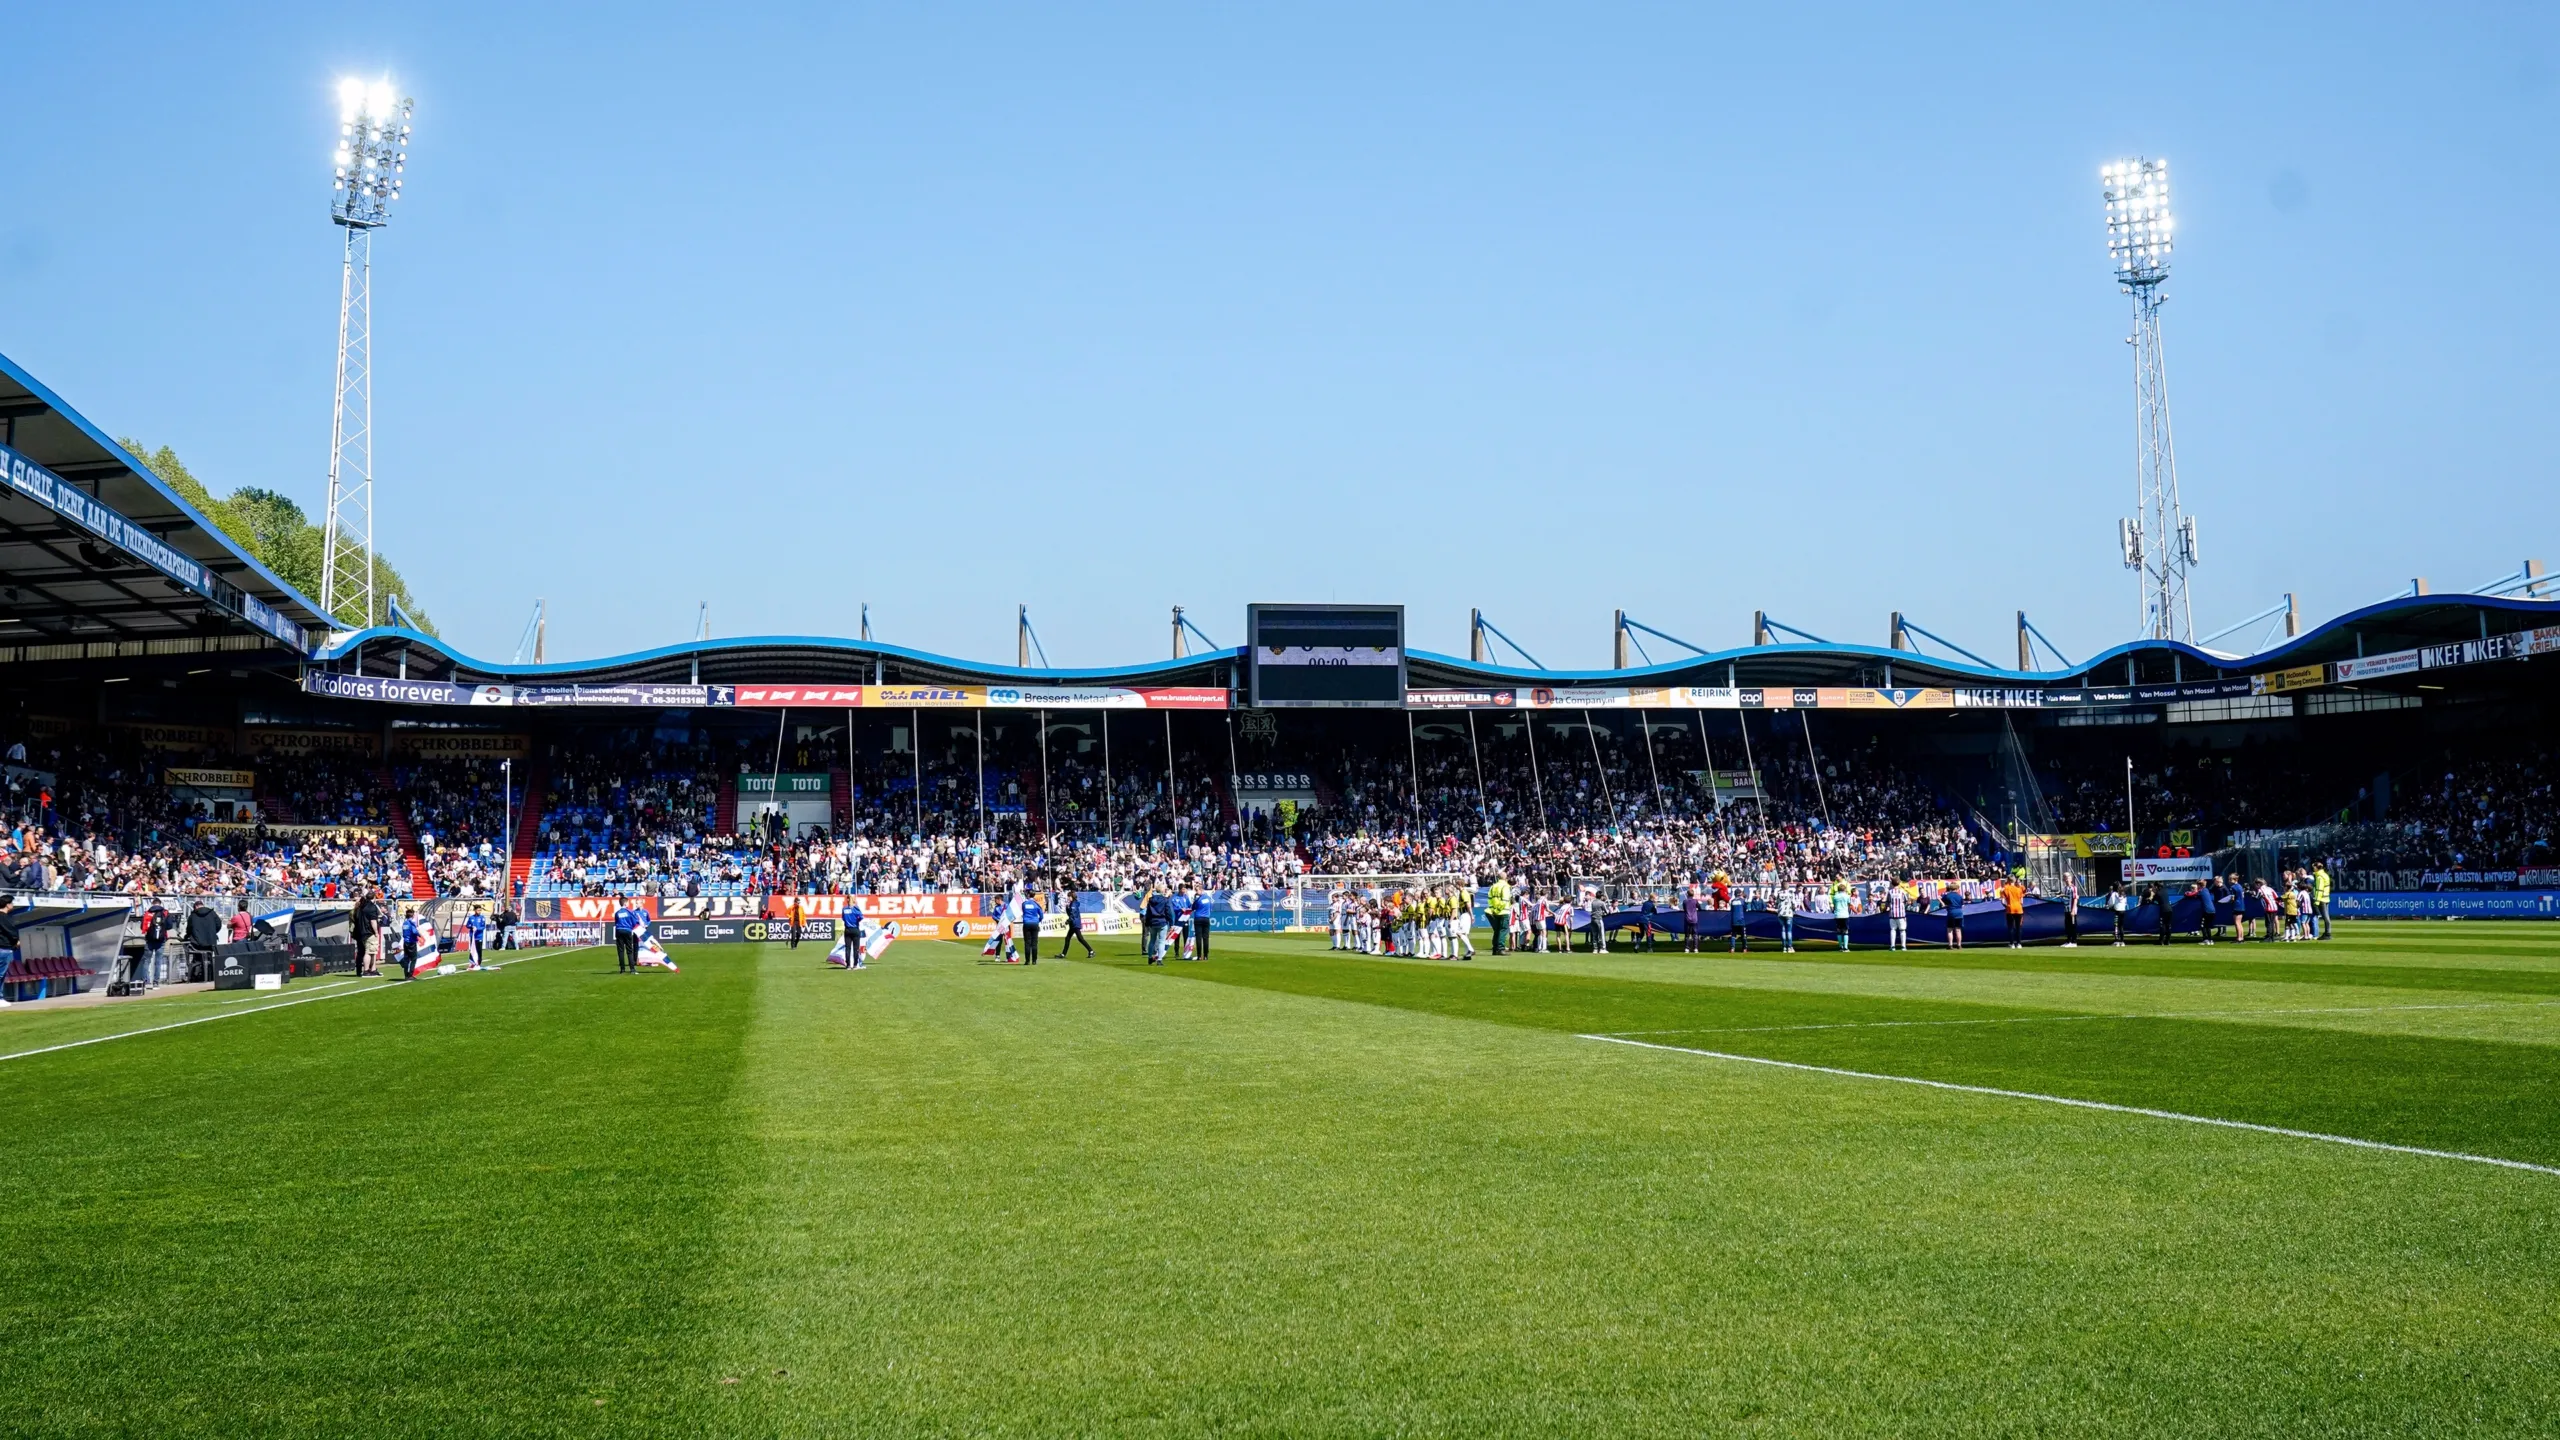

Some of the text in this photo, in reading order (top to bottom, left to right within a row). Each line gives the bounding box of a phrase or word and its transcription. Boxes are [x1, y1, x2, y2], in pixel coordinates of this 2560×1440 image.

[13, 459, 55, 509] GLORIE,
[58, 483, 85, 522] DENK
[87, 502, 107, 537] AAN
[109, 514, 121, 542] DE
[124, 523, 199, 587] VRIENDSCHAPSBAND
[315, 673, 455, 702] Tricolores forever.
[2195, 687, 2215, 695] Mossel
[2232, 683, 2249, 691] Mossel
[910, 691, 969, 700] RIEL
[1024, 693, 1070, 703] Bressers
[1073, 693, 1108, 703] Metaal
[1407, 693, 1491, 703] DE TWEEWIELER
[1692, 689, 1732, 698] REIJRINK
[2059, 694, 2081, 702] Mossel
[2108, 692, 2131, 700] Mossel
[2154, 690, 2176, 698] Mossel
[1150, 694, 1224, 703] www.brusselsairport.nl
[1565, 695, 1615, 706] Company.nl
[1740, 692, 1762, 705] capi
[1794, 692, 1816, 705] capi
[168, 771, 249, 784] SCHROBBELÈR
[746, 778, 821, 790] TOTO TOTO
[2454, 871, 2484, 883] BRISTOL
[2526, 868, 2560, 886] KRUIKE
[2338, 897, 2361, 910] hallo,
[2362, 898, 2374, 909] ICT
[2377, 898, 2425, 912] oplossingen
[2428, 898, 2435, 909] is
[2438, 898, 2449, 909] de
[2452, 898, 2485, 909] nieuwe
[2488, 899, 2514, 909] naam
[2516, 899, 2535, 909] van
[1222, 916, 1239, 925] ICT
[902, 924, 939, 932] Van Hees
[971, 923, 987, 931] Van
[1104, 923, 1129, 931] FORCE
